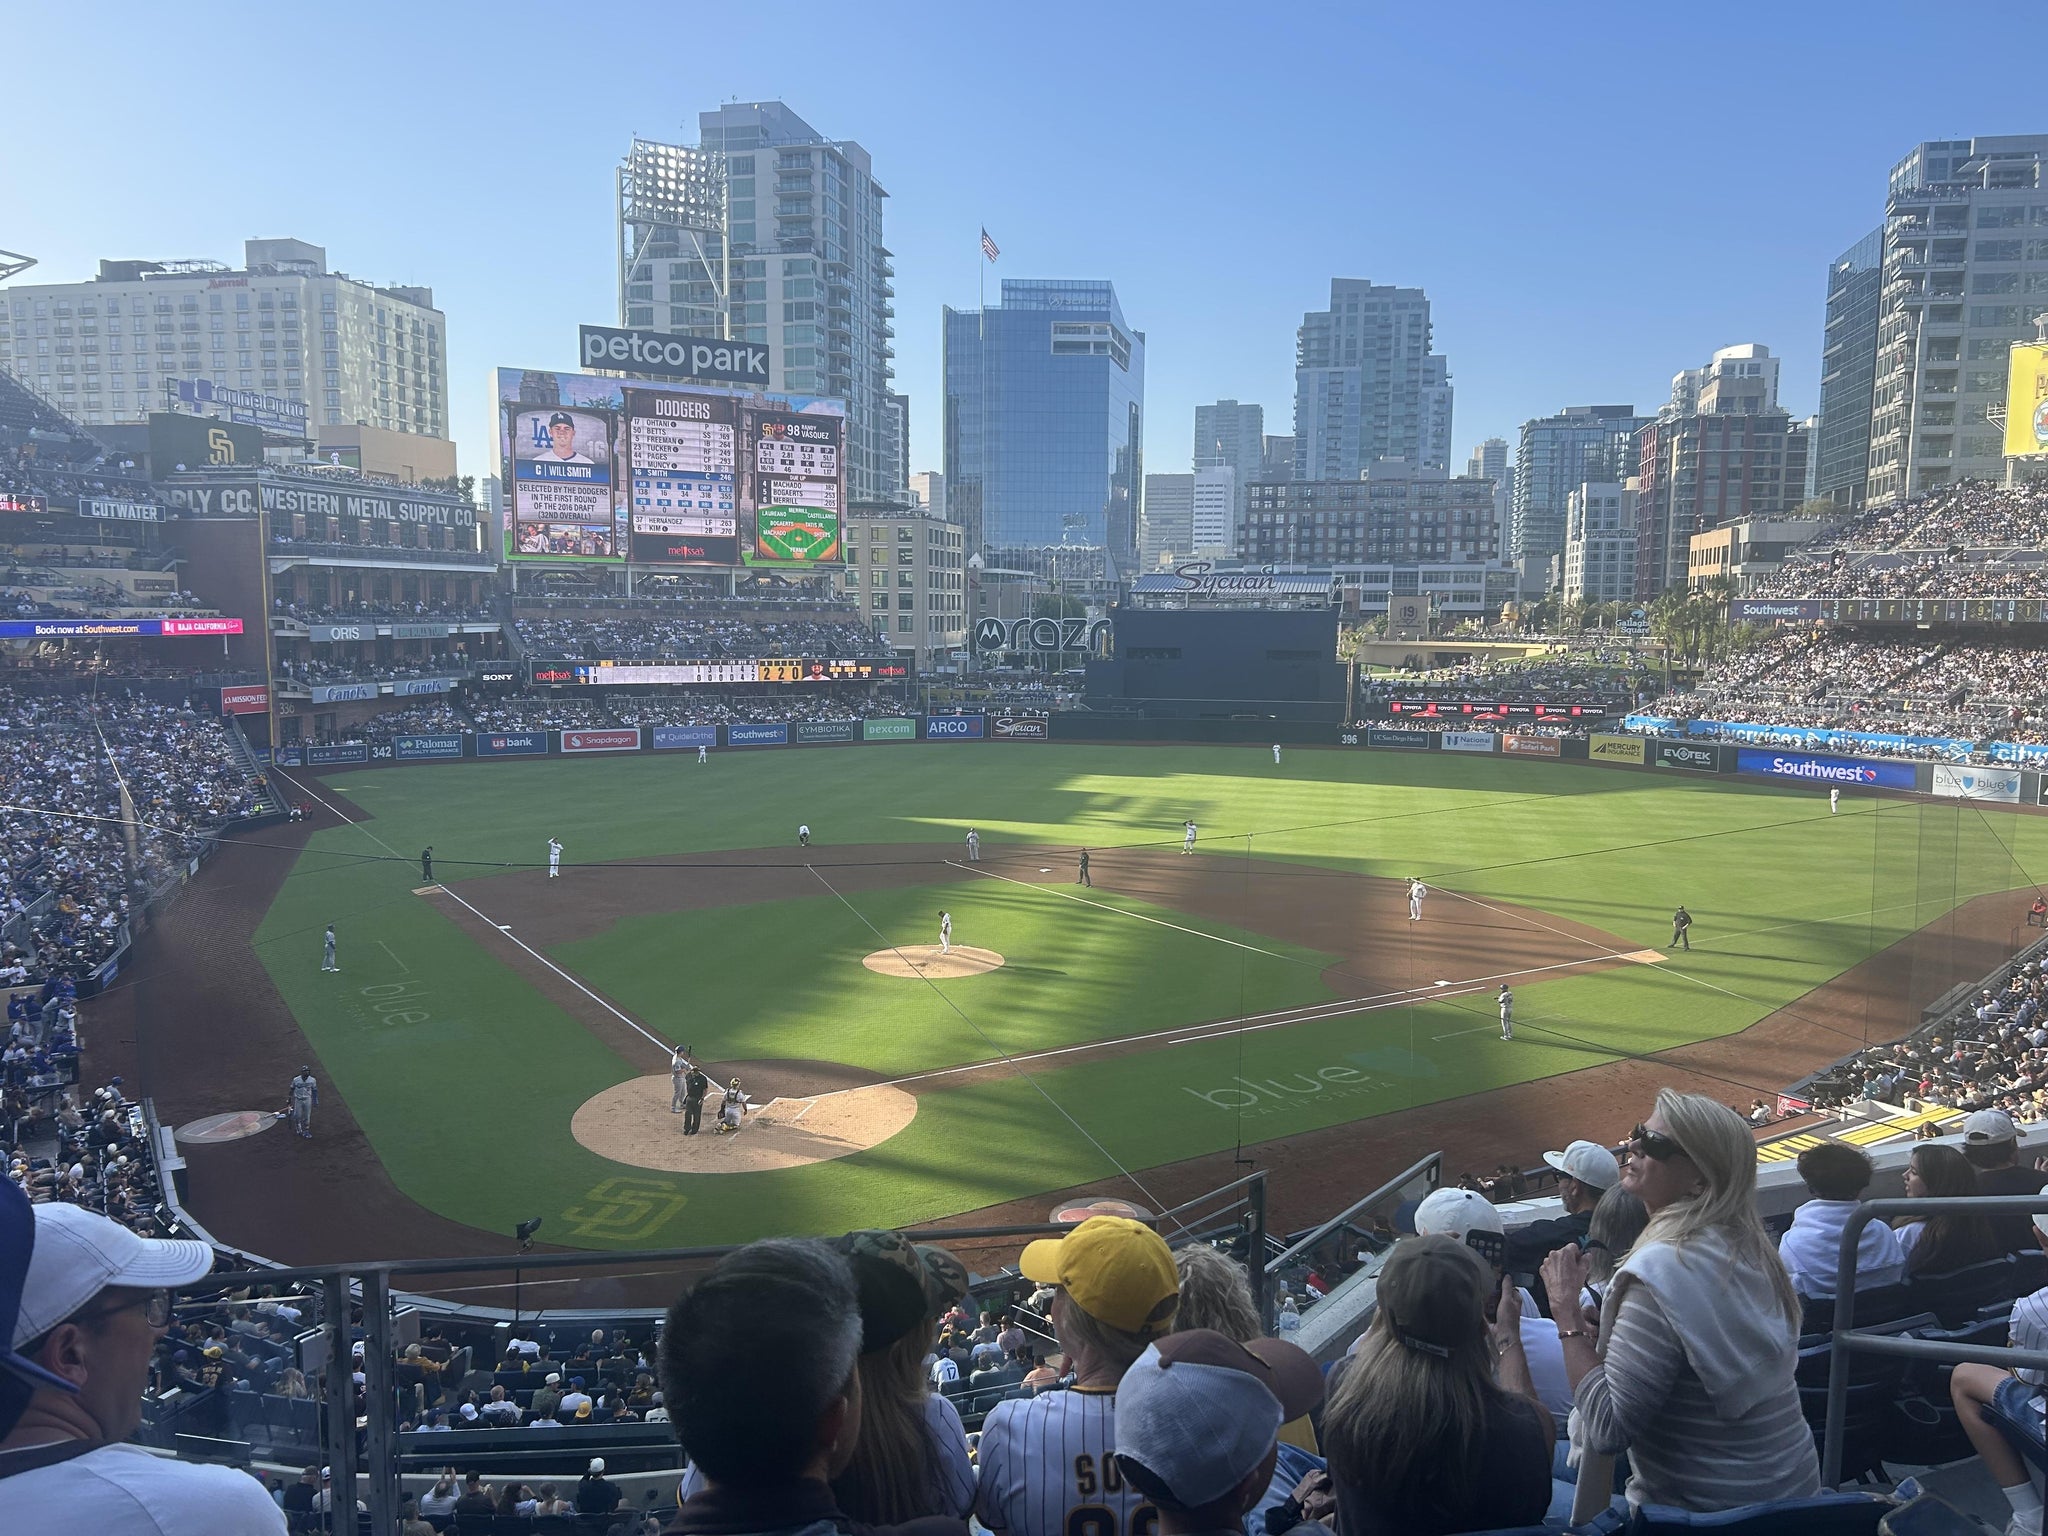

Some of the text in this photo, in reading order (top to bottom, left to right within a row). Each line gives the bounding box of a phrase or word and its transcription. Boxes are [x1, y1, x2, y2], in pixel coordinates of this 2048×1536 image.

[585, 333, 766, 376] petco park
[656, 399, 710, 419] DODGERS
[646, 428, 666, 436] BETTS
[787, 424, 800, 436] 98
[647, 445, 672, 453] TUCKER
[648, 461, 670, 469] MUNCY
[549, 466, 566, 477] WILL
[567, 467, 592, 478] SMITH
[648, 469, 668, 477] SMITH
[519, 484, 552, 493] SELECTED
[564, 486, 576, 494] THE
[578, 487, 608, 496] DODGERS
[773, 481, 802, 489] MACHADO
[540, 494, 552, 502] THE
[554, 495, 572, 503] FIRST
[575, 496, 597, 504] ROUND
[773, 489, 803, 497] BOGAERTS
[221, 489, 258, 514] CO.
[261, 487, 476, 527] WESTERN METAL SUPPLY CO.
[773, 497, 798, 505] MERRILL
[91, 502, 158, 521] CUTWATER
[558, 503, 573, 511] 2016
[574, 504, 594, 512] DRAFT
[1172, 562, 1277, 600] Sycuan
[1743, 604, 1799, 616] Southwest
[35, 625, 56, 635] Book
[75, 626, 84, 634] at
[178, 623, 193, 631] BAJA
[194, 622, 227, 631] CALIFORNIA
[1621, 626, 1650, 634] Square
[331, 627, 360, 639] ORIS
[1010, 617, 1112, 651] razr
[764, 667, 798, 680] 2 2 0
[231, 694, 257, 703] MISSION
[279, 702, 295, 715] 336
[929, 721, 968, 733] ARCO
[995, 718, 1042, 737] Sycuan
[585, 734, 632, 746] Snapdragon
[668, 730, 714, 741] QuidelOrtho
[732, 730, 779, 740] Southwest
[1341, 734, 1358, 745] 396
[1460, 736, 1490, 744] National
[415, 739, 459, 749] Palomar
[492, 735, 533, 748] us bank
[1608, 742, 1641, 751] MERCURY
[372, 746, 392, 758] 342
[1540, 744, 1556, 752] Park
[1607, 749, 1641, 758] INSURANCE
[1663, 746, 1711, 760] EVOTEK
[1773, 757, 1867, 783] Southwest
[1935, 774, 2005, 790] blue blue
[1181, 1066, 1371, 1111] blue
[1239, 1081, 1396, 1119] CALIFORNIA
[946, 1366, 957, 1380] 17
